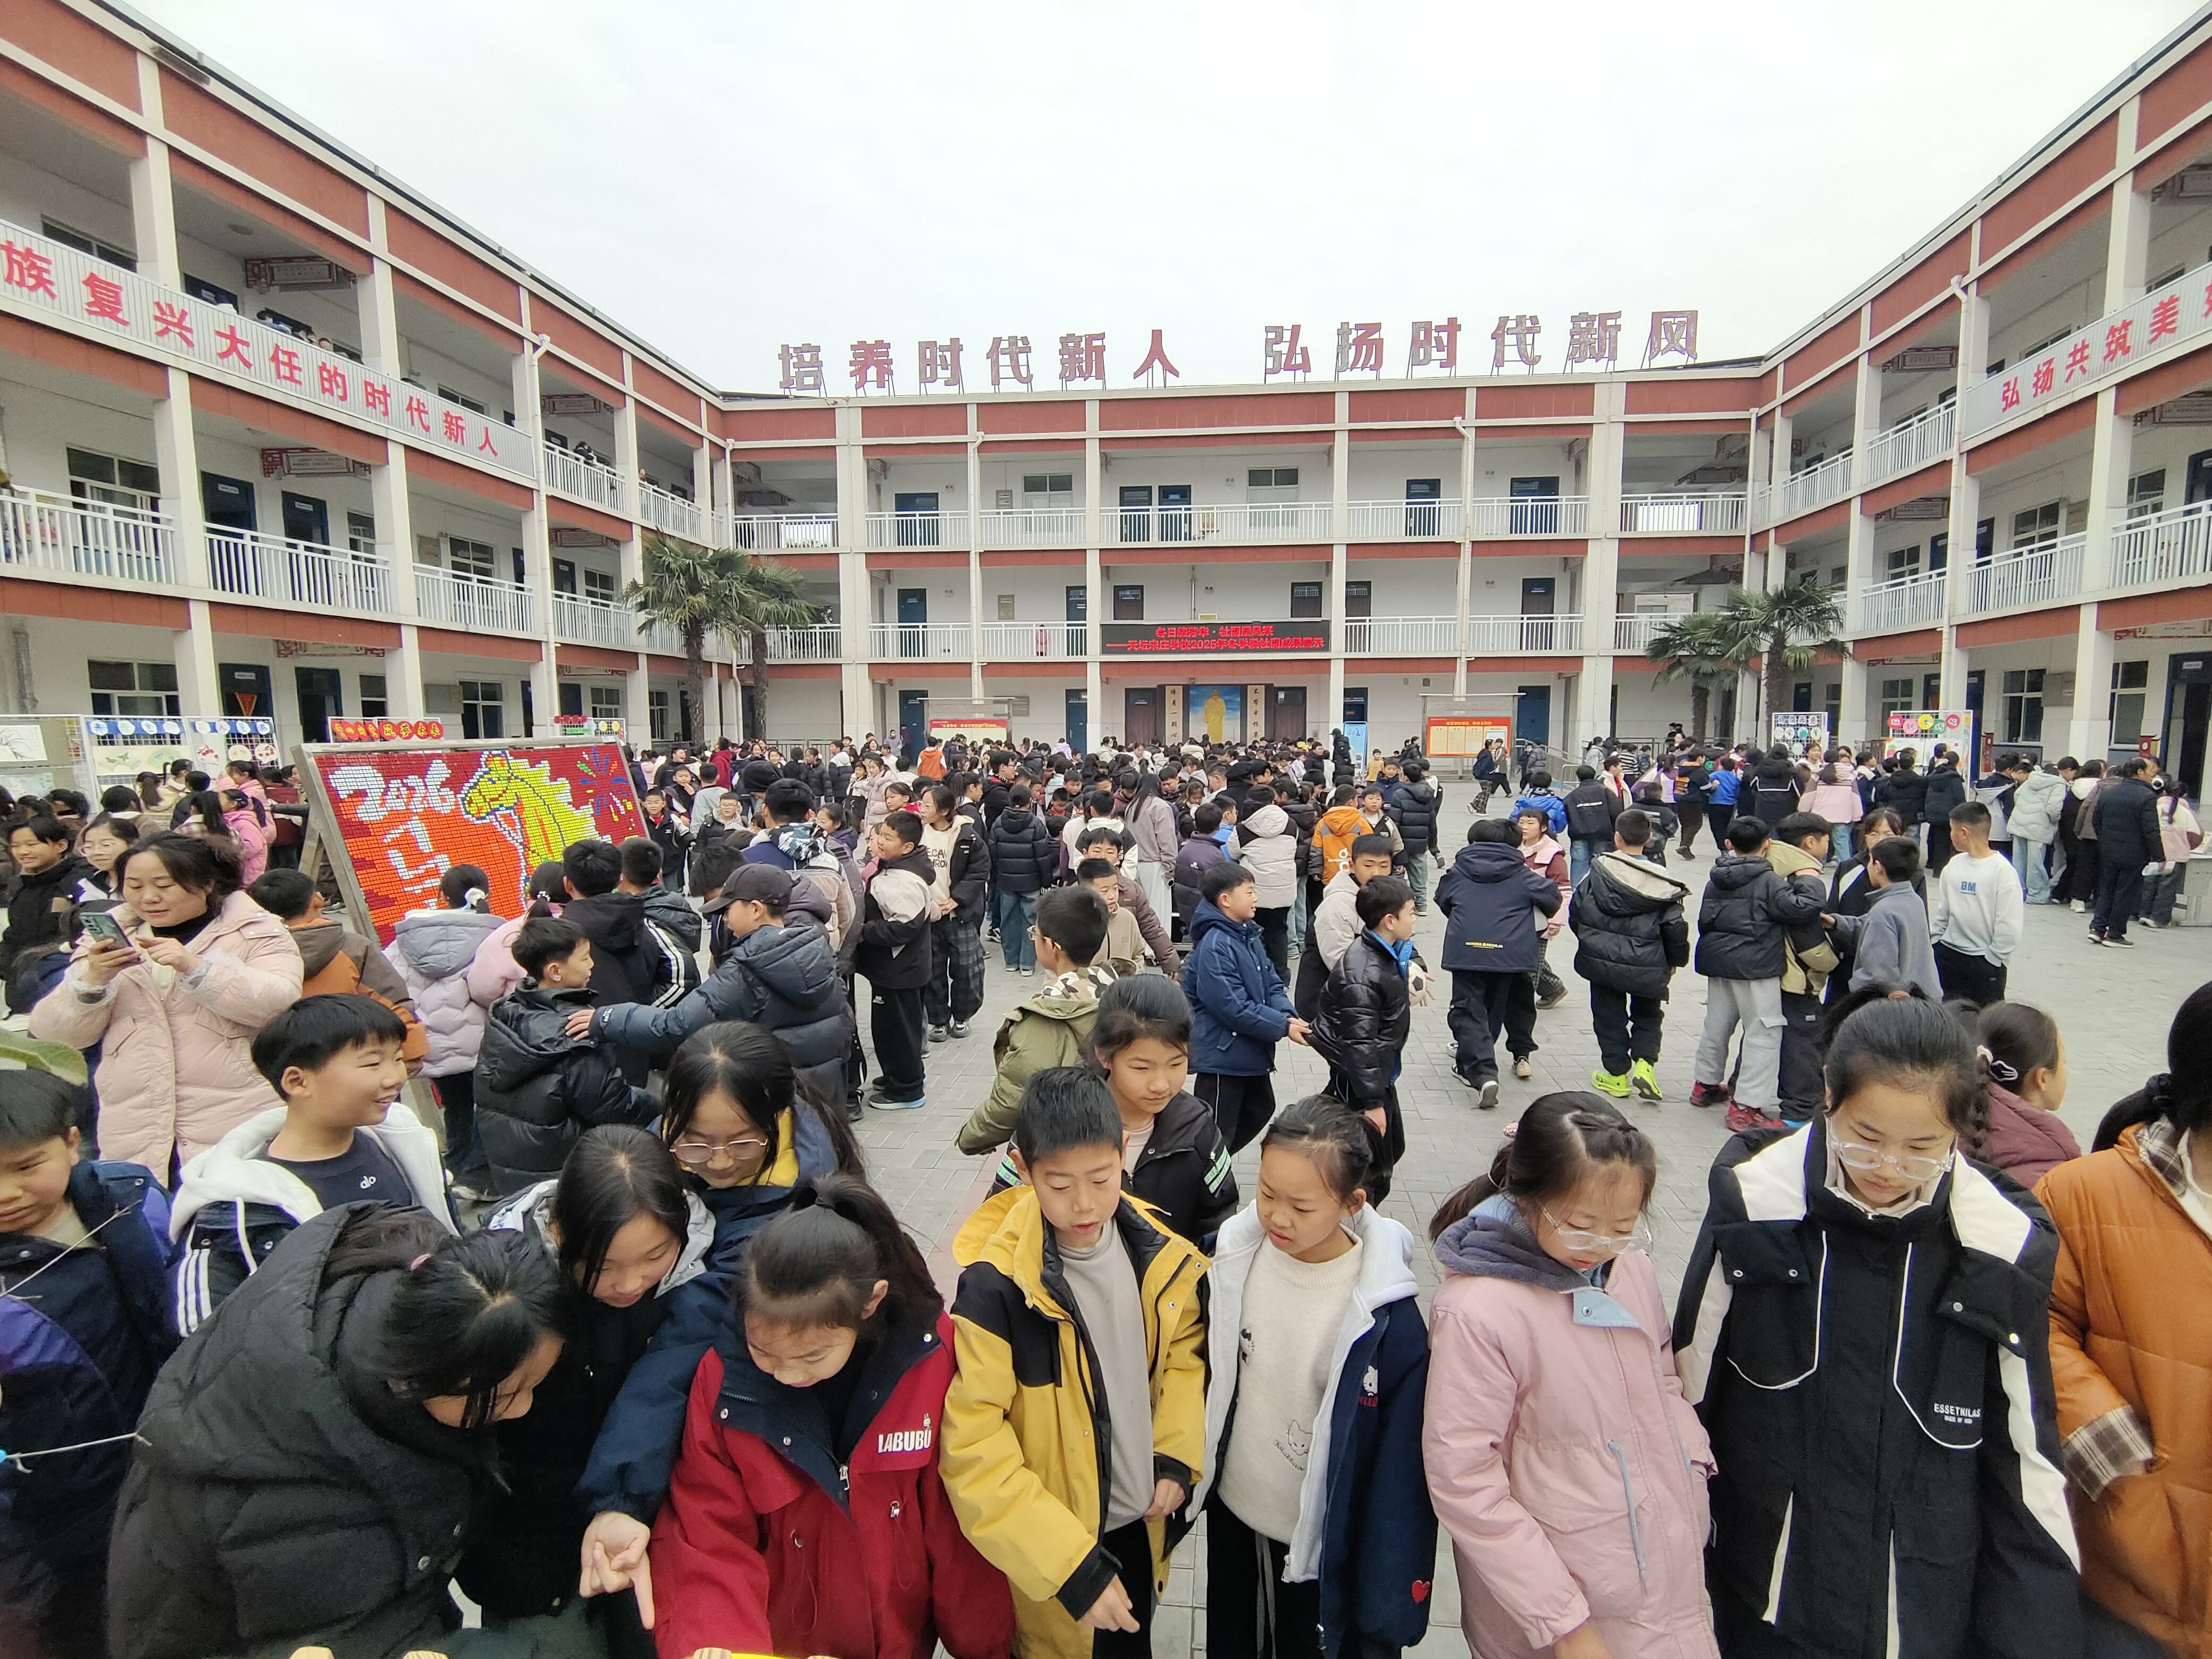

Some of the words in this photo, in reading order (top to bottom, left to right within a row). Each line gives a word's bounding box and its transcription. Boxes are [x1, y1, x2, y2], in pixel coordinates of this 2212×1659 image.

[0, 239, 499, 457] 族复兴大任的时代新人
[778, 329, 1179, 390] 培养时代新人
[1264, 310, 1699, 374] 弘扬时代新风
[1960, 881, 1976, 892] BM
[360, 1175, 376, 1189] alo
[1933, 1403, 1981, 1418] ESSETNILAS
[877, 1429, 932, 1454] LABUBU
